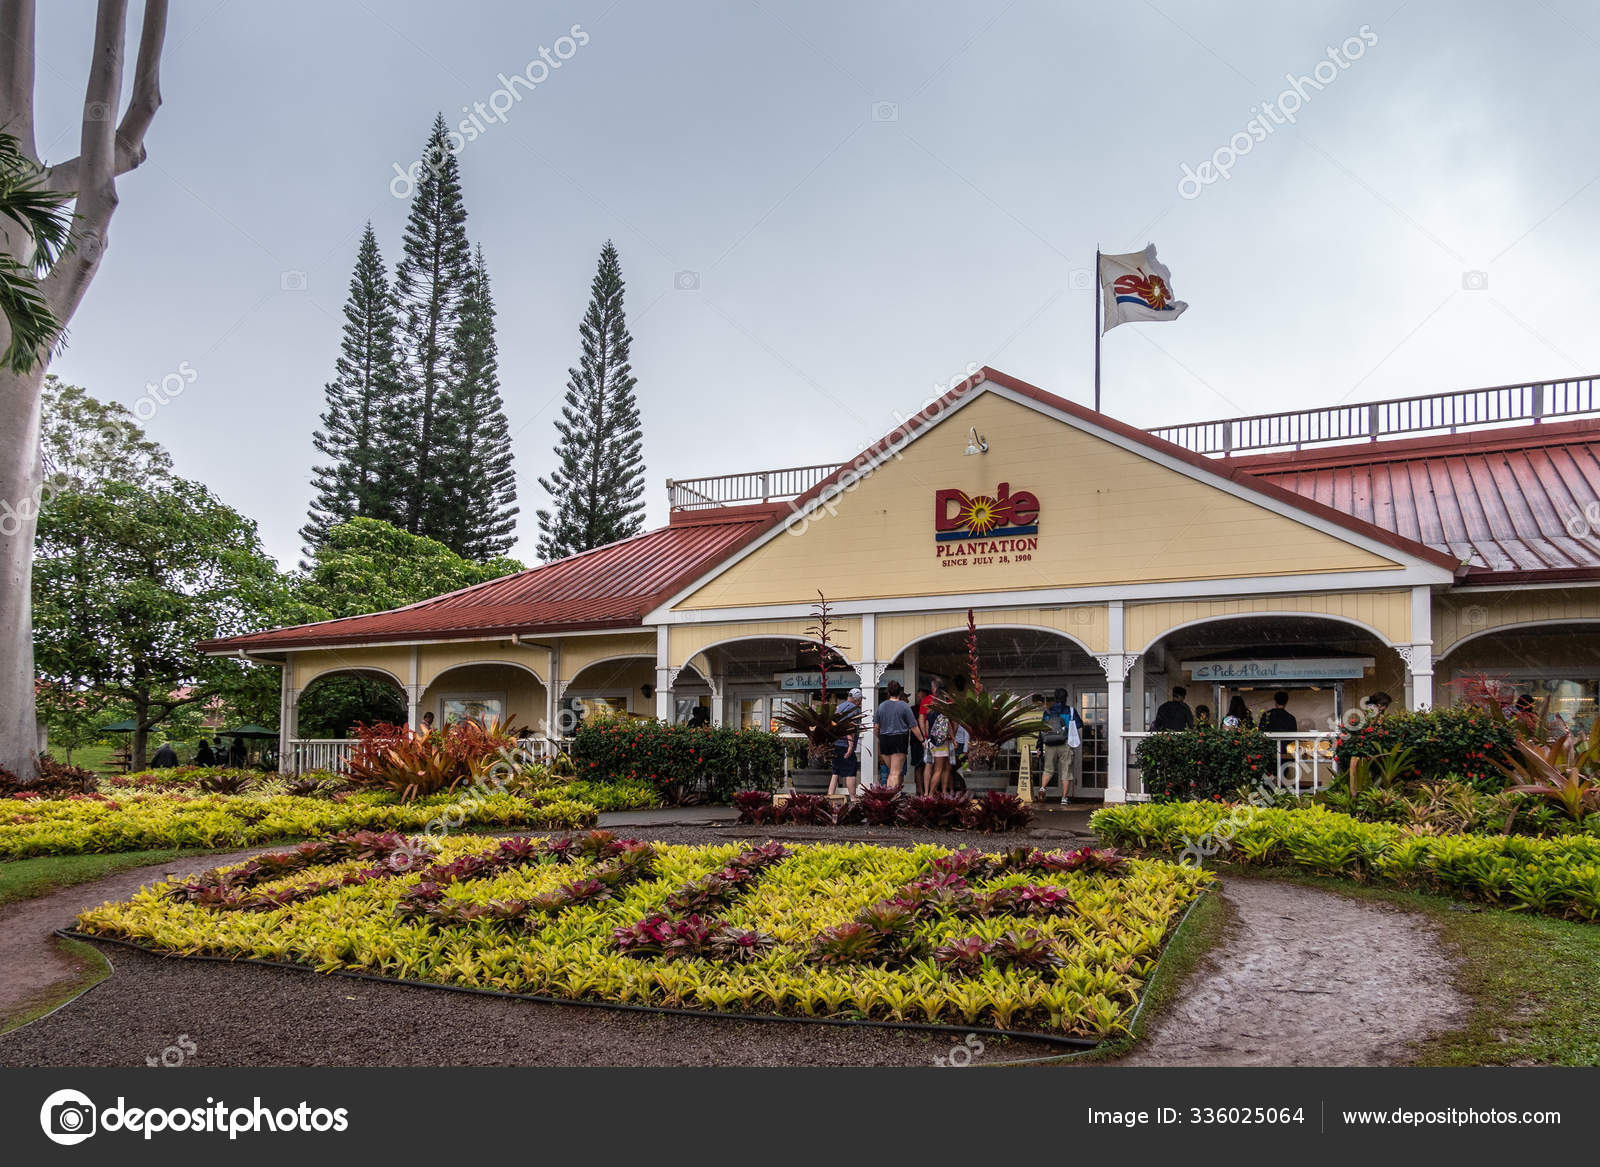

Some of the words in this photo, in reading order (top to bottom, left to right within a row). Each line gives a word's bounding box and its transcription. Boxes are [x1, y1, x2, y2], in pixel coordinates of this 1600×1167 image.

[936, 482, 1040, 532] Dole
[936, 537, 1038, 557] PLANTATION
[942, 557, 968, 567] SINCE
[973, 556, 994, 565] JULY
[999, 555, 1010, 564] 28,
[1015, 553, 1032, 562] 1900
[1212, 664, 1234, 677] Pick
[1248, 663, 1278, 676] Pearl
